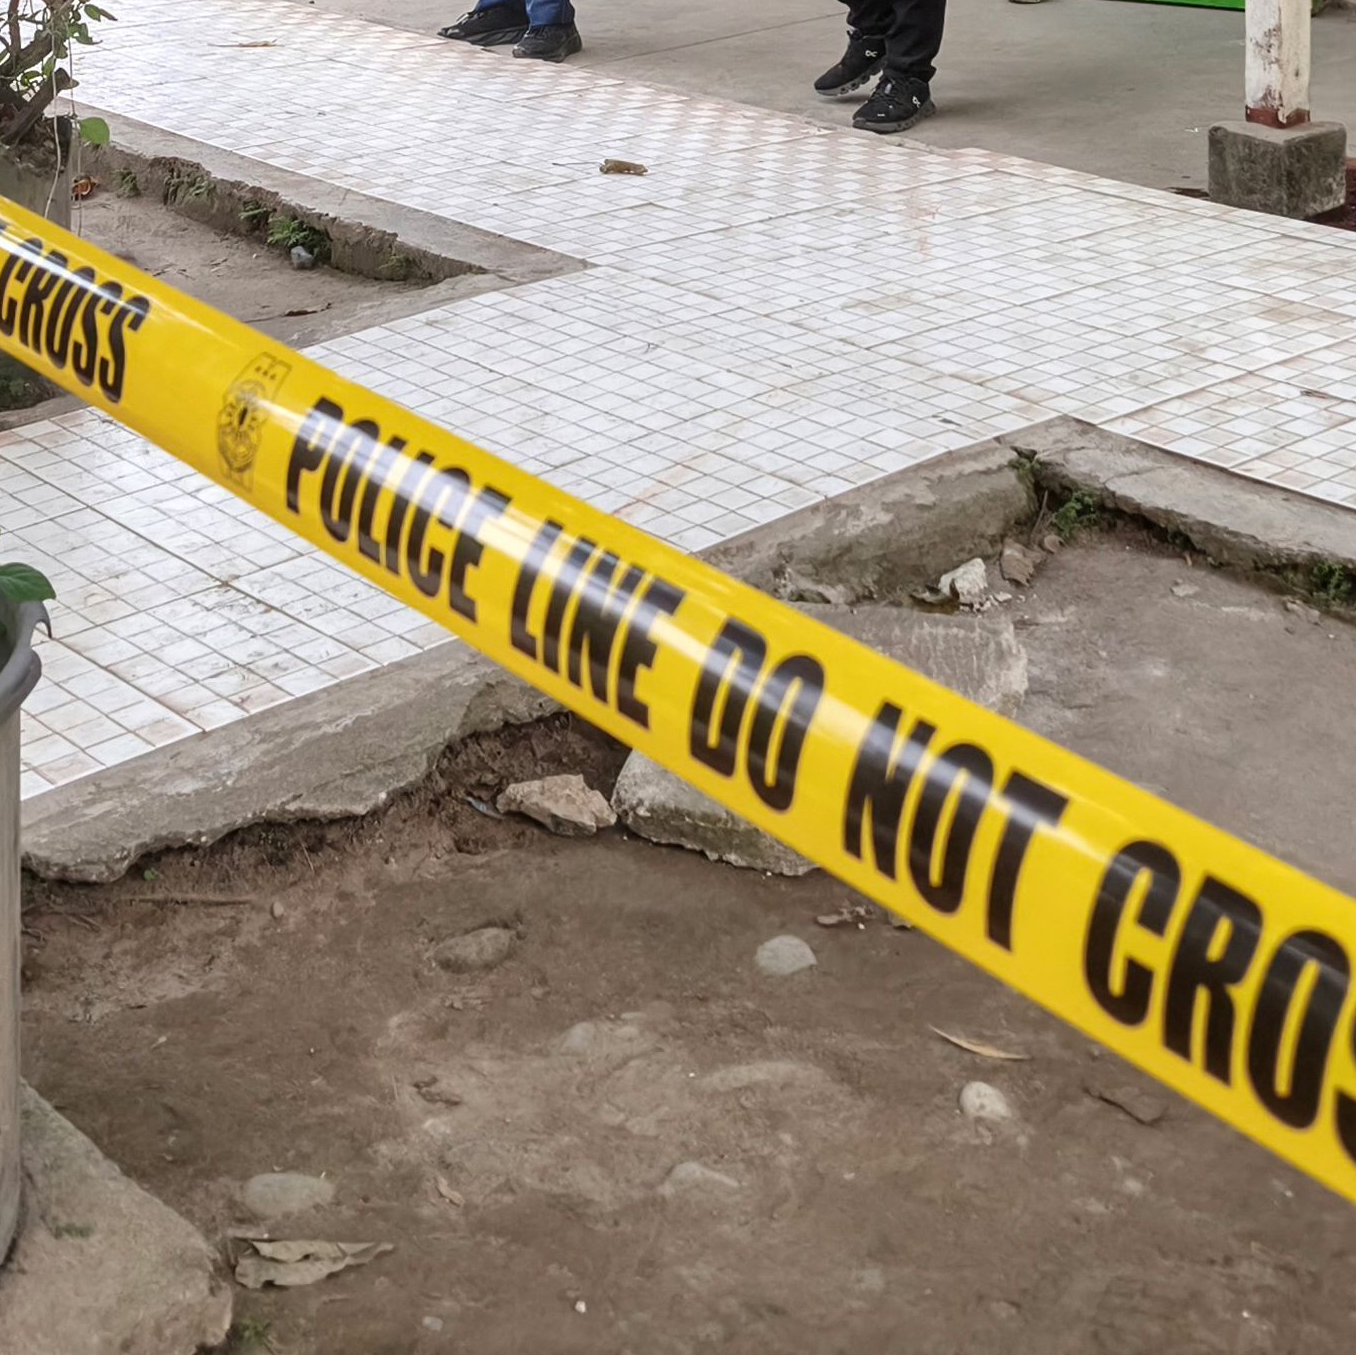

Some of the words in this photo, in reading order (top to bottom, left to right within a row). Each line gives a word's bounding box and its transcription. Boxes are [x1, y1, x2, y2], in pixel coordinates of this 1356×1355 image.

[285, 396, 512, 624] POLICE
[510, 519, 687, 731] LINE
[688, 617, 825, 812] DO
[843, 700, 1068, 953] NOT
